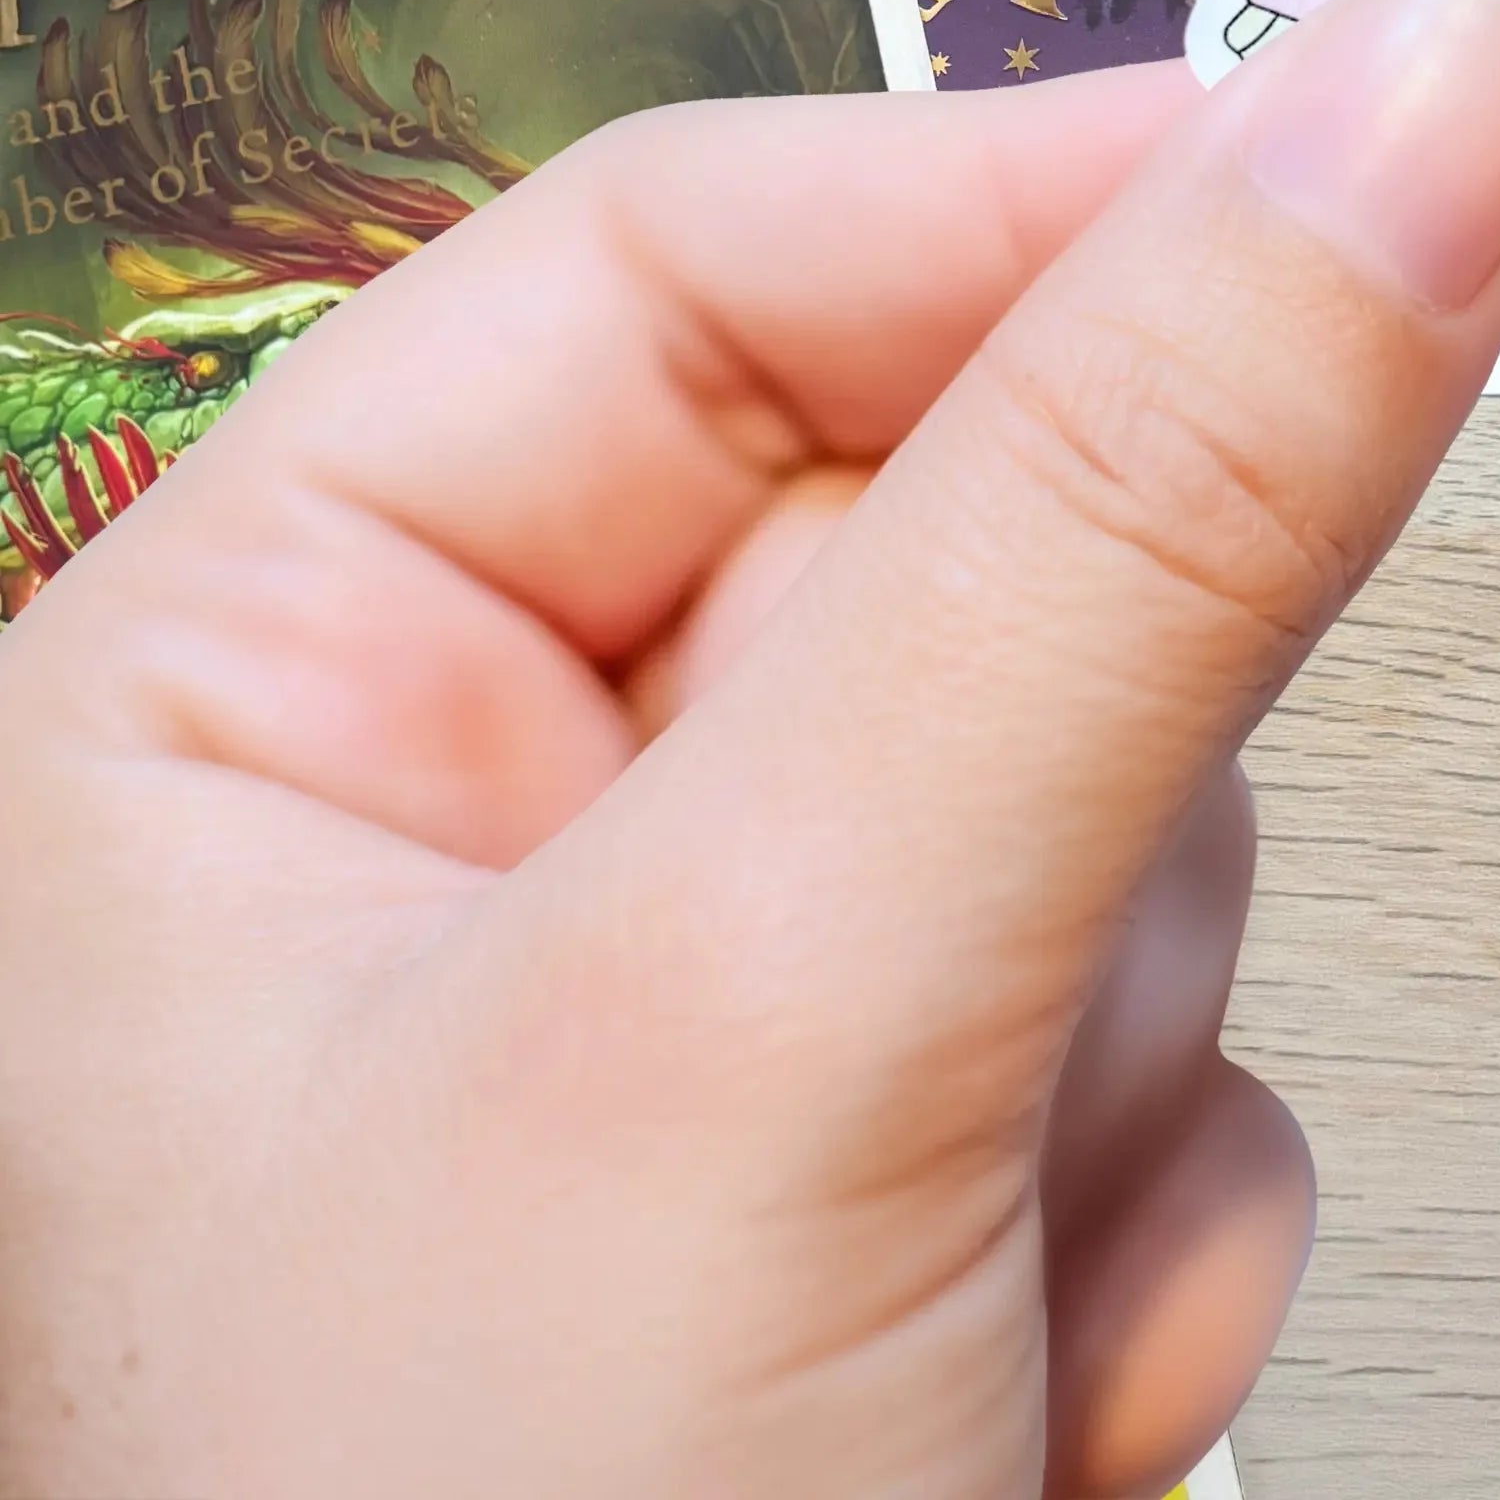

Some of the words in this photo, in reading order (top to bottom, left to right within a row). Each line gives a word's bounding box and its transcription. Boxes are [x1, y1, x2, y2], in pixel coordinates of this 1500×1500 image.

[7, 62, 130, 147] and
[149, 45, 258, 114] the
[150, 130, 215, 204] of
[238, 94, 478, 184] Secrets
